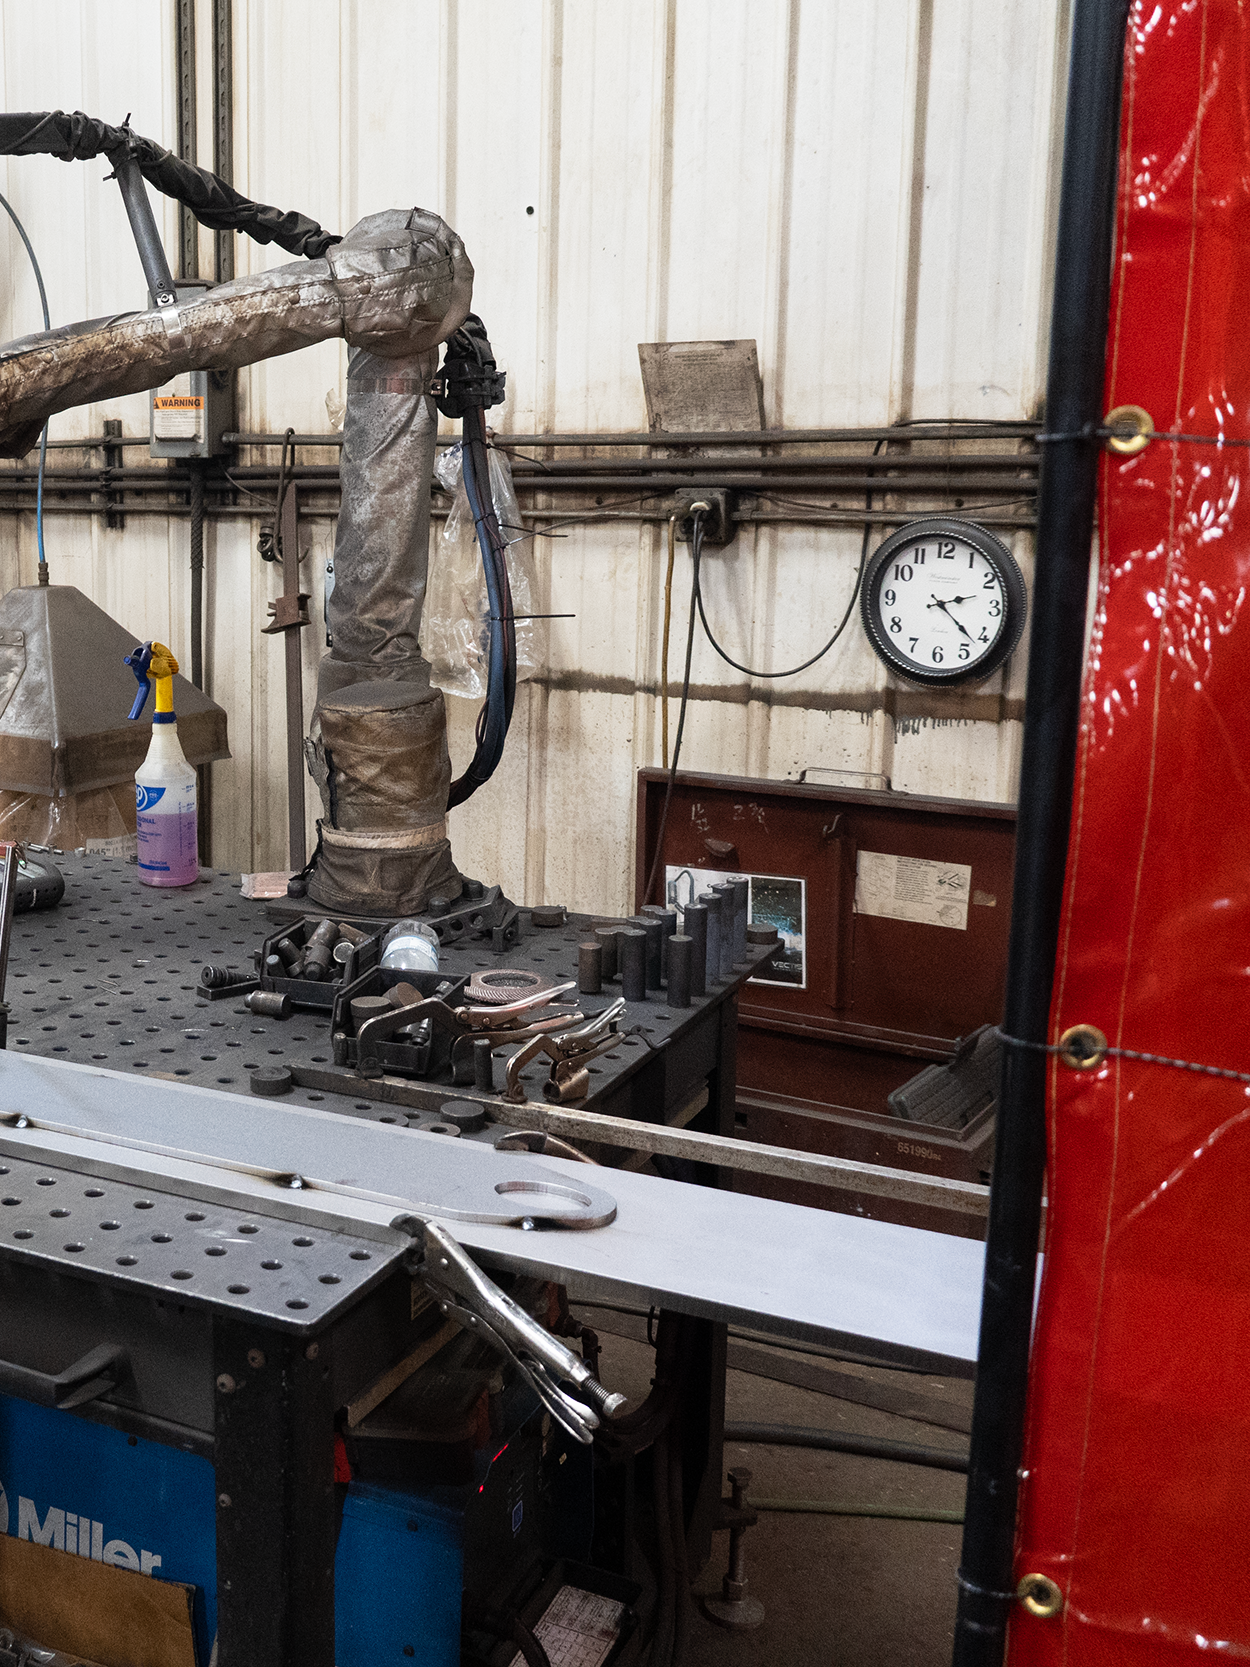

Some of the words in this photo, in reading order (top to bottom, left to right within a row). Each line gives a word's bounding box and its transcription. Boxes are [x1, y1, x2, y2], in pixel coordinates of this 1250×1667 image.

[161, 398, 201, 407] WARNING
[914, 547, 926, 564] 11
[937, 542, 955, 559] 12
[968, 552, 975, 568] 1
[894, 564, 913, 581] 10
[983, 572, 996, 589] 2
[885, 589, 896, 606] 9
[988, 599, 1001, 617] 3
[890, 616, 902, 633] 8
[977, 626, 990, 643] 4
[908, 637, 919, 653] 7
[958, 643, 970, 660] 5
[932, 646, 943, 663] 6
[18, 1495, 162, 1576] Miller
